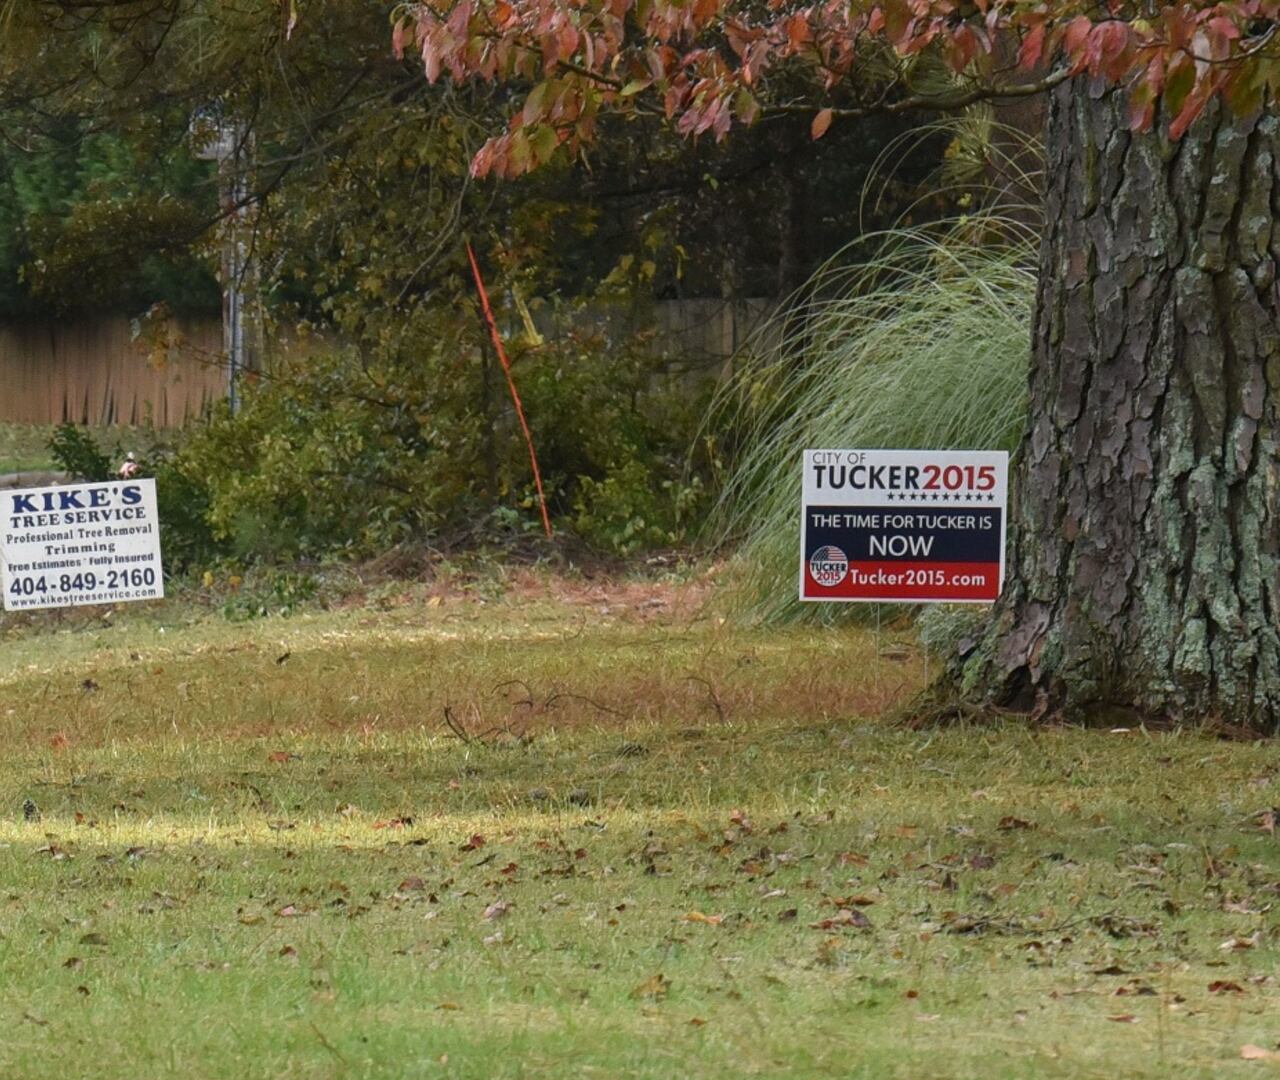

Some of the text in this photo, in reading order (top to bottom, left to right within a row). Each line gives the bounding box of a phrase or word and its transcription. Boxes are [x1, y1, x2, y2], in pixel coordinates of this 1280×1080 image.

[812, 452, 867, 465] CITY OF
[11, 486, 142, 514] KIKE'S
[10, 507, 146, 529] TREE SERVICE
[811, 514, 992, 529] THE TIME FOR TUCKER IS
[6, 524, 152, 545] Professional Tree Removal
[44, 542, 116, 556] Trimming
[869, 534, 935, 556] NOW
[8, 553, 154, 572] Free Estimates Fully Insured
[811, 562, 847, 572] TUCKER
[10, 567, 155, 596] 404-849-2160
[816, 571, 841, 581] 2015
[850, 568, 986, 586] Tucker2015.com
[10, 589, 156, 607] www.kikestreeservice.com
